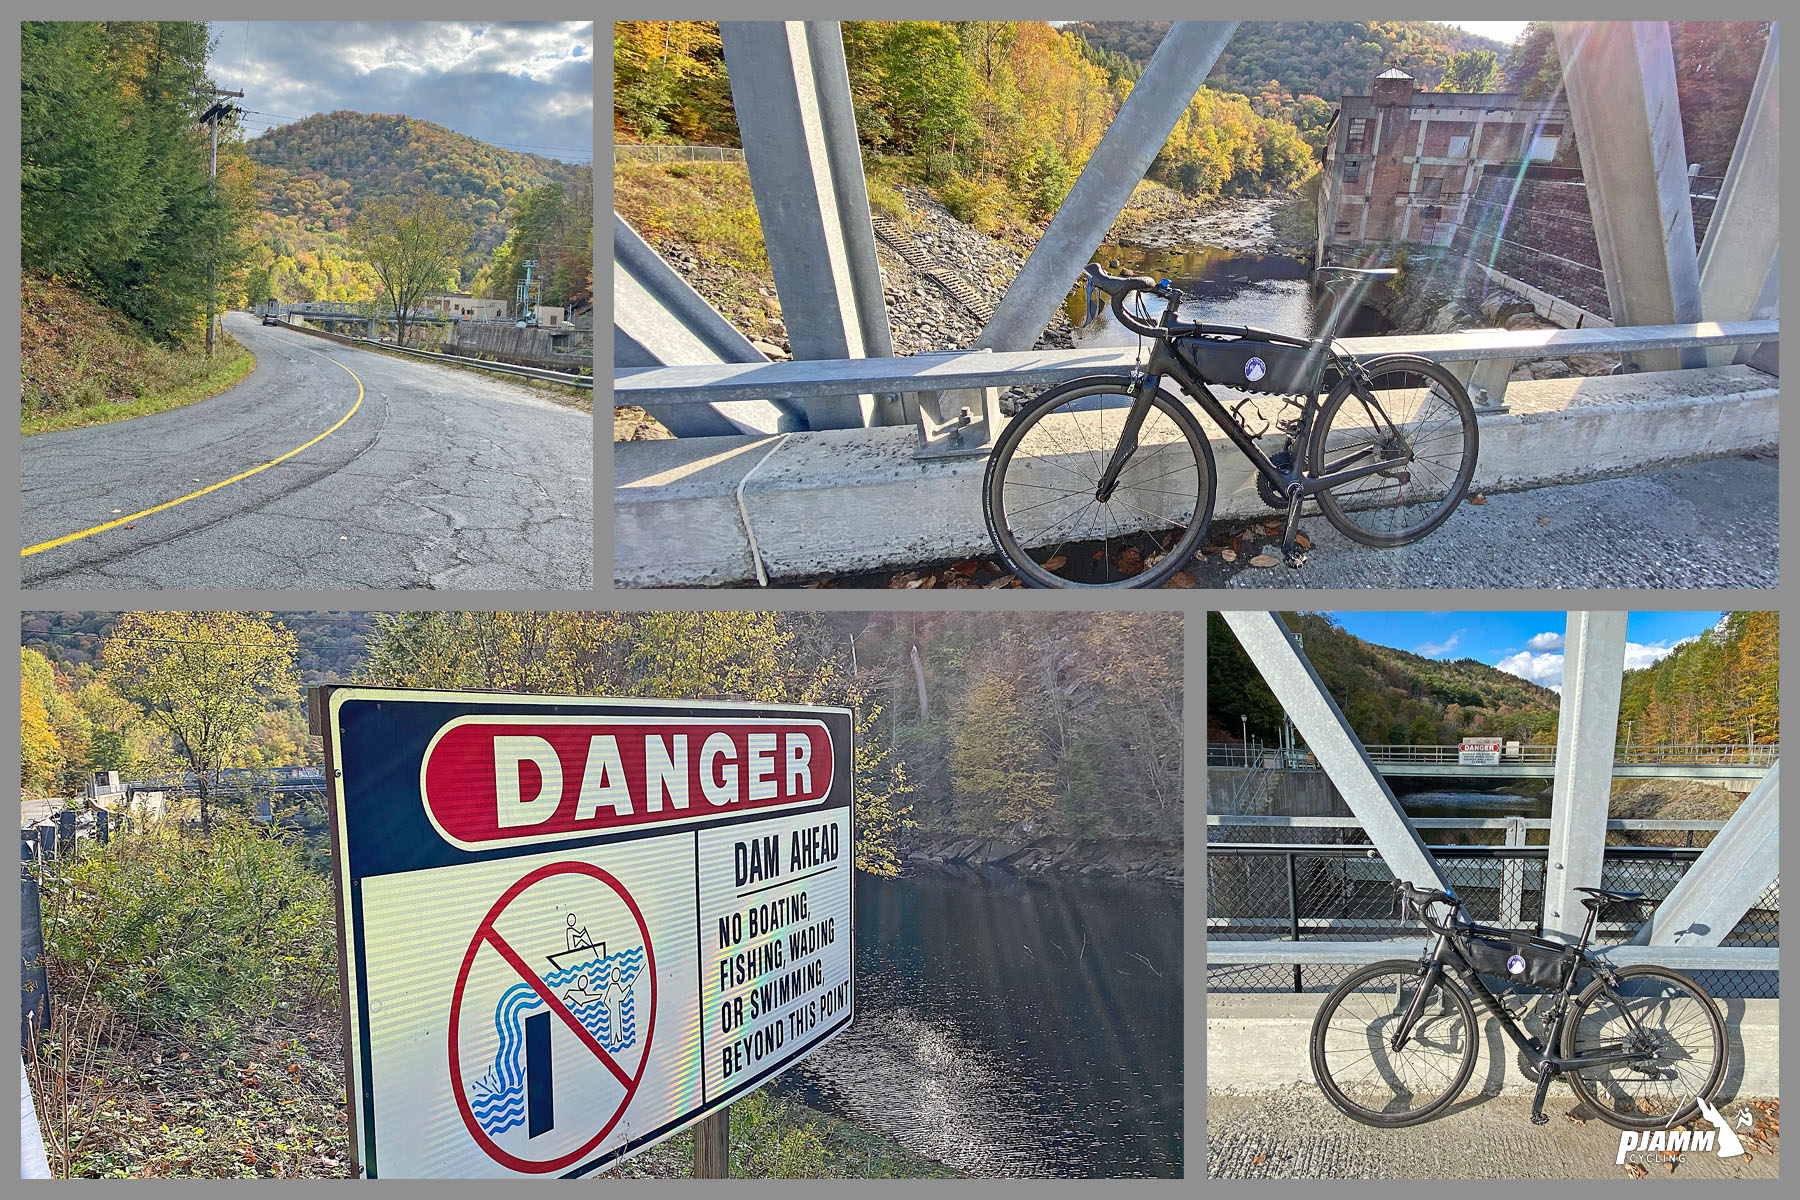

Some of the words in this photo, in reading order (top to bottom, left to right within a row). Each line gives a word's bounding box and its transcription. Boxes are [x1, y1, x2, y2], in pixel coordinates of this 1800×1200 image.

[493, 732, 813, 828] DANGER
[734, 834, 780, 888] DAM
[790, 822, 839, 873] AHEAD
[719, 912, 742, 949] NO
[749, 891, 811, 939] BOATING,
[720, 939, 786, 992] FISHING,
[789, 917, 835, 961] WADING
[721, 996, 744, 1034] OR
[750, 958, 825, 1020] SWIMMING,
[722, 1019, 784, 1079] BEYOND
[788, 1000, 816, 1041] THIS
[820, 979, 849, 1022] POINT
